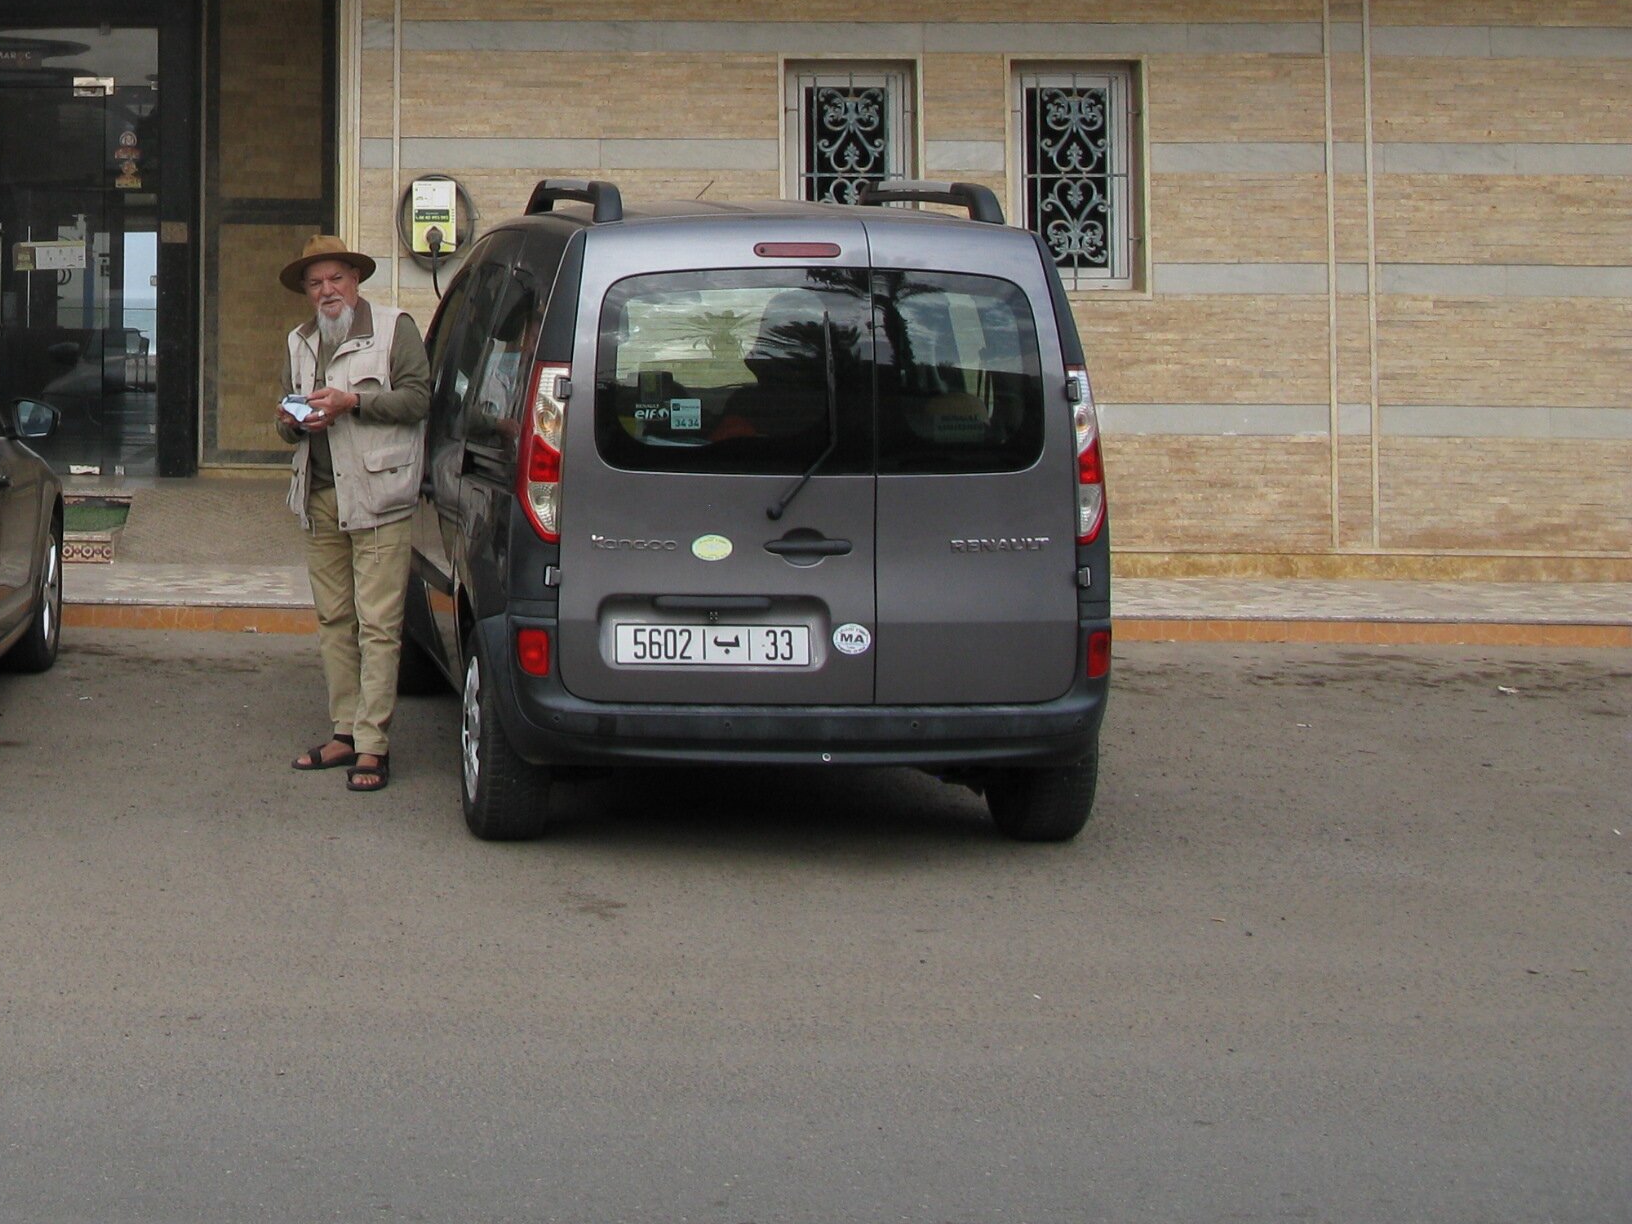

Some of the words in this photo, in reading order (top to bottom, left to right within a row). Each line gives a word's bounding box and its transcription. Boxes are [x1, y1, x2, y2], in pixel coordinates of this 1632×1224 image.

[634, 409, 658, 420] elf
[950, 536, 1051, 554] RENAULT
[633, 628, 693, 660] 5602
[764, 629, 794, 662] 33
[840, 633, 864, 644] MA
